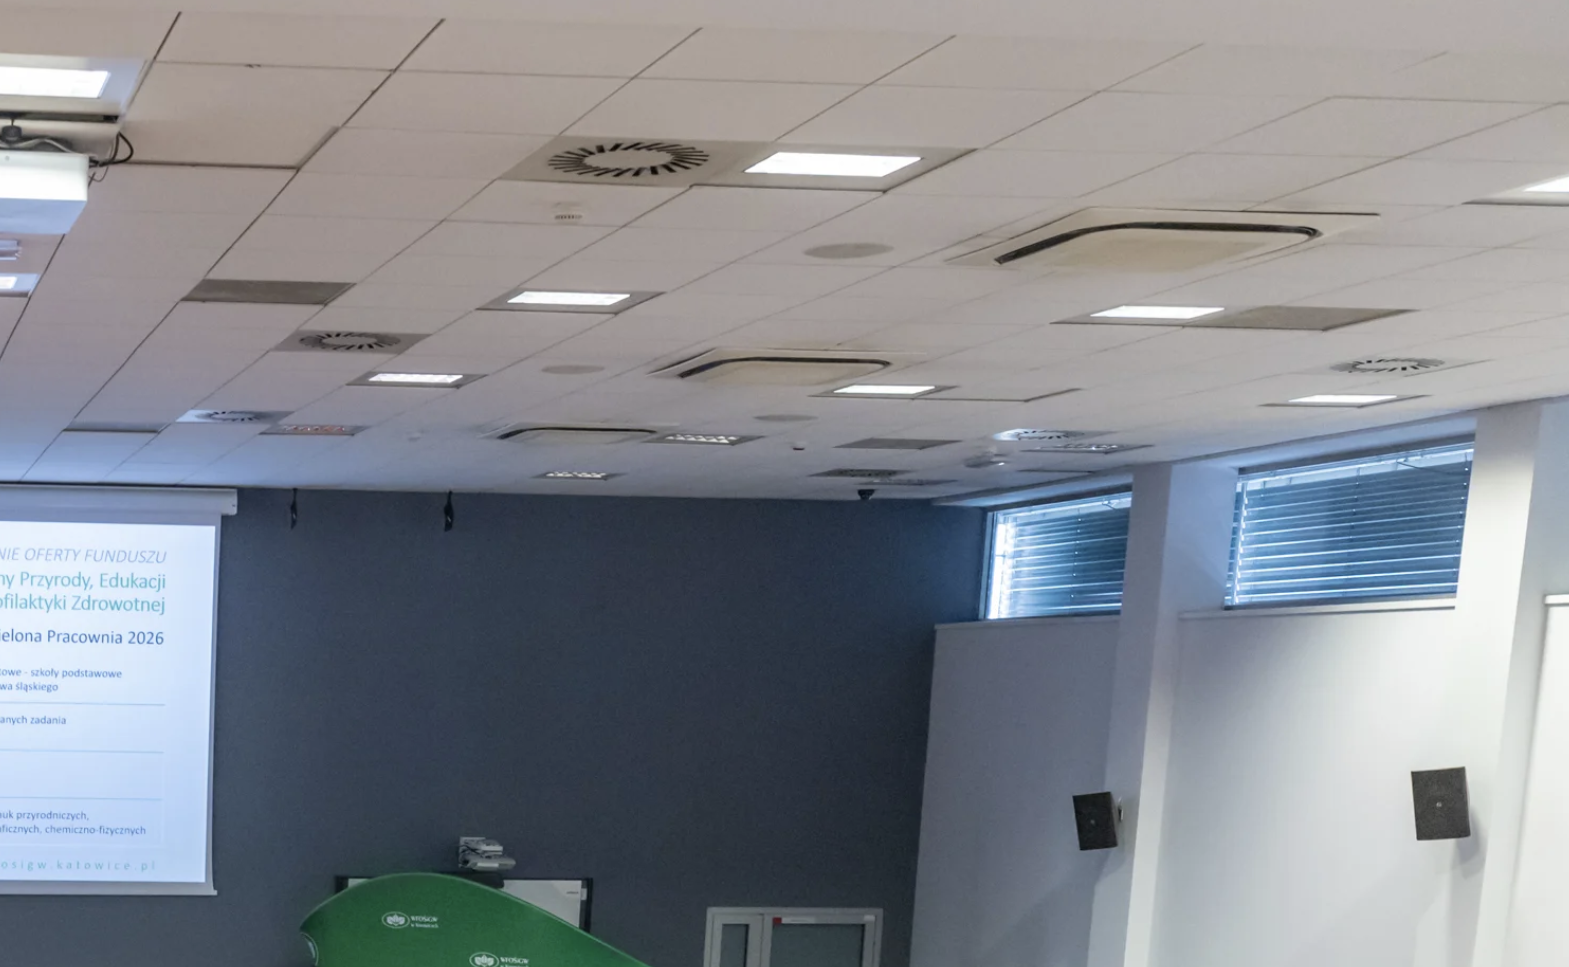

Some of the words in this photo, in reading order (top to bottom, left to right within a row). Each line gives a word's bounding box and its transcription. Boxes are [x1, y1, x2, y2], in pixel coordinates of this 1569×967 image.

[24, 547, 81, 562] OFERTY
[84, 549, 167, 564] FUNDUSZU
[20, 571, 94, 590] Przyrody,
[100, 572, 166, 592] Edukacji
[71, 595, 166, 616] Zdrowotnej
[47, 629, 124, 644] Pracownia
[128, 630, 164, 646] 2026
[30, 668, 60, 678] szkoły
[62, 668, 122, 679] podstawowe
[16, 682, 58, 693] śląskiego
[30, 716, 66, 724] zadania
[16, 810, 90, 821] przyrodniczych,
[45, 825, 146, 836] chemiczno-fizycznych
